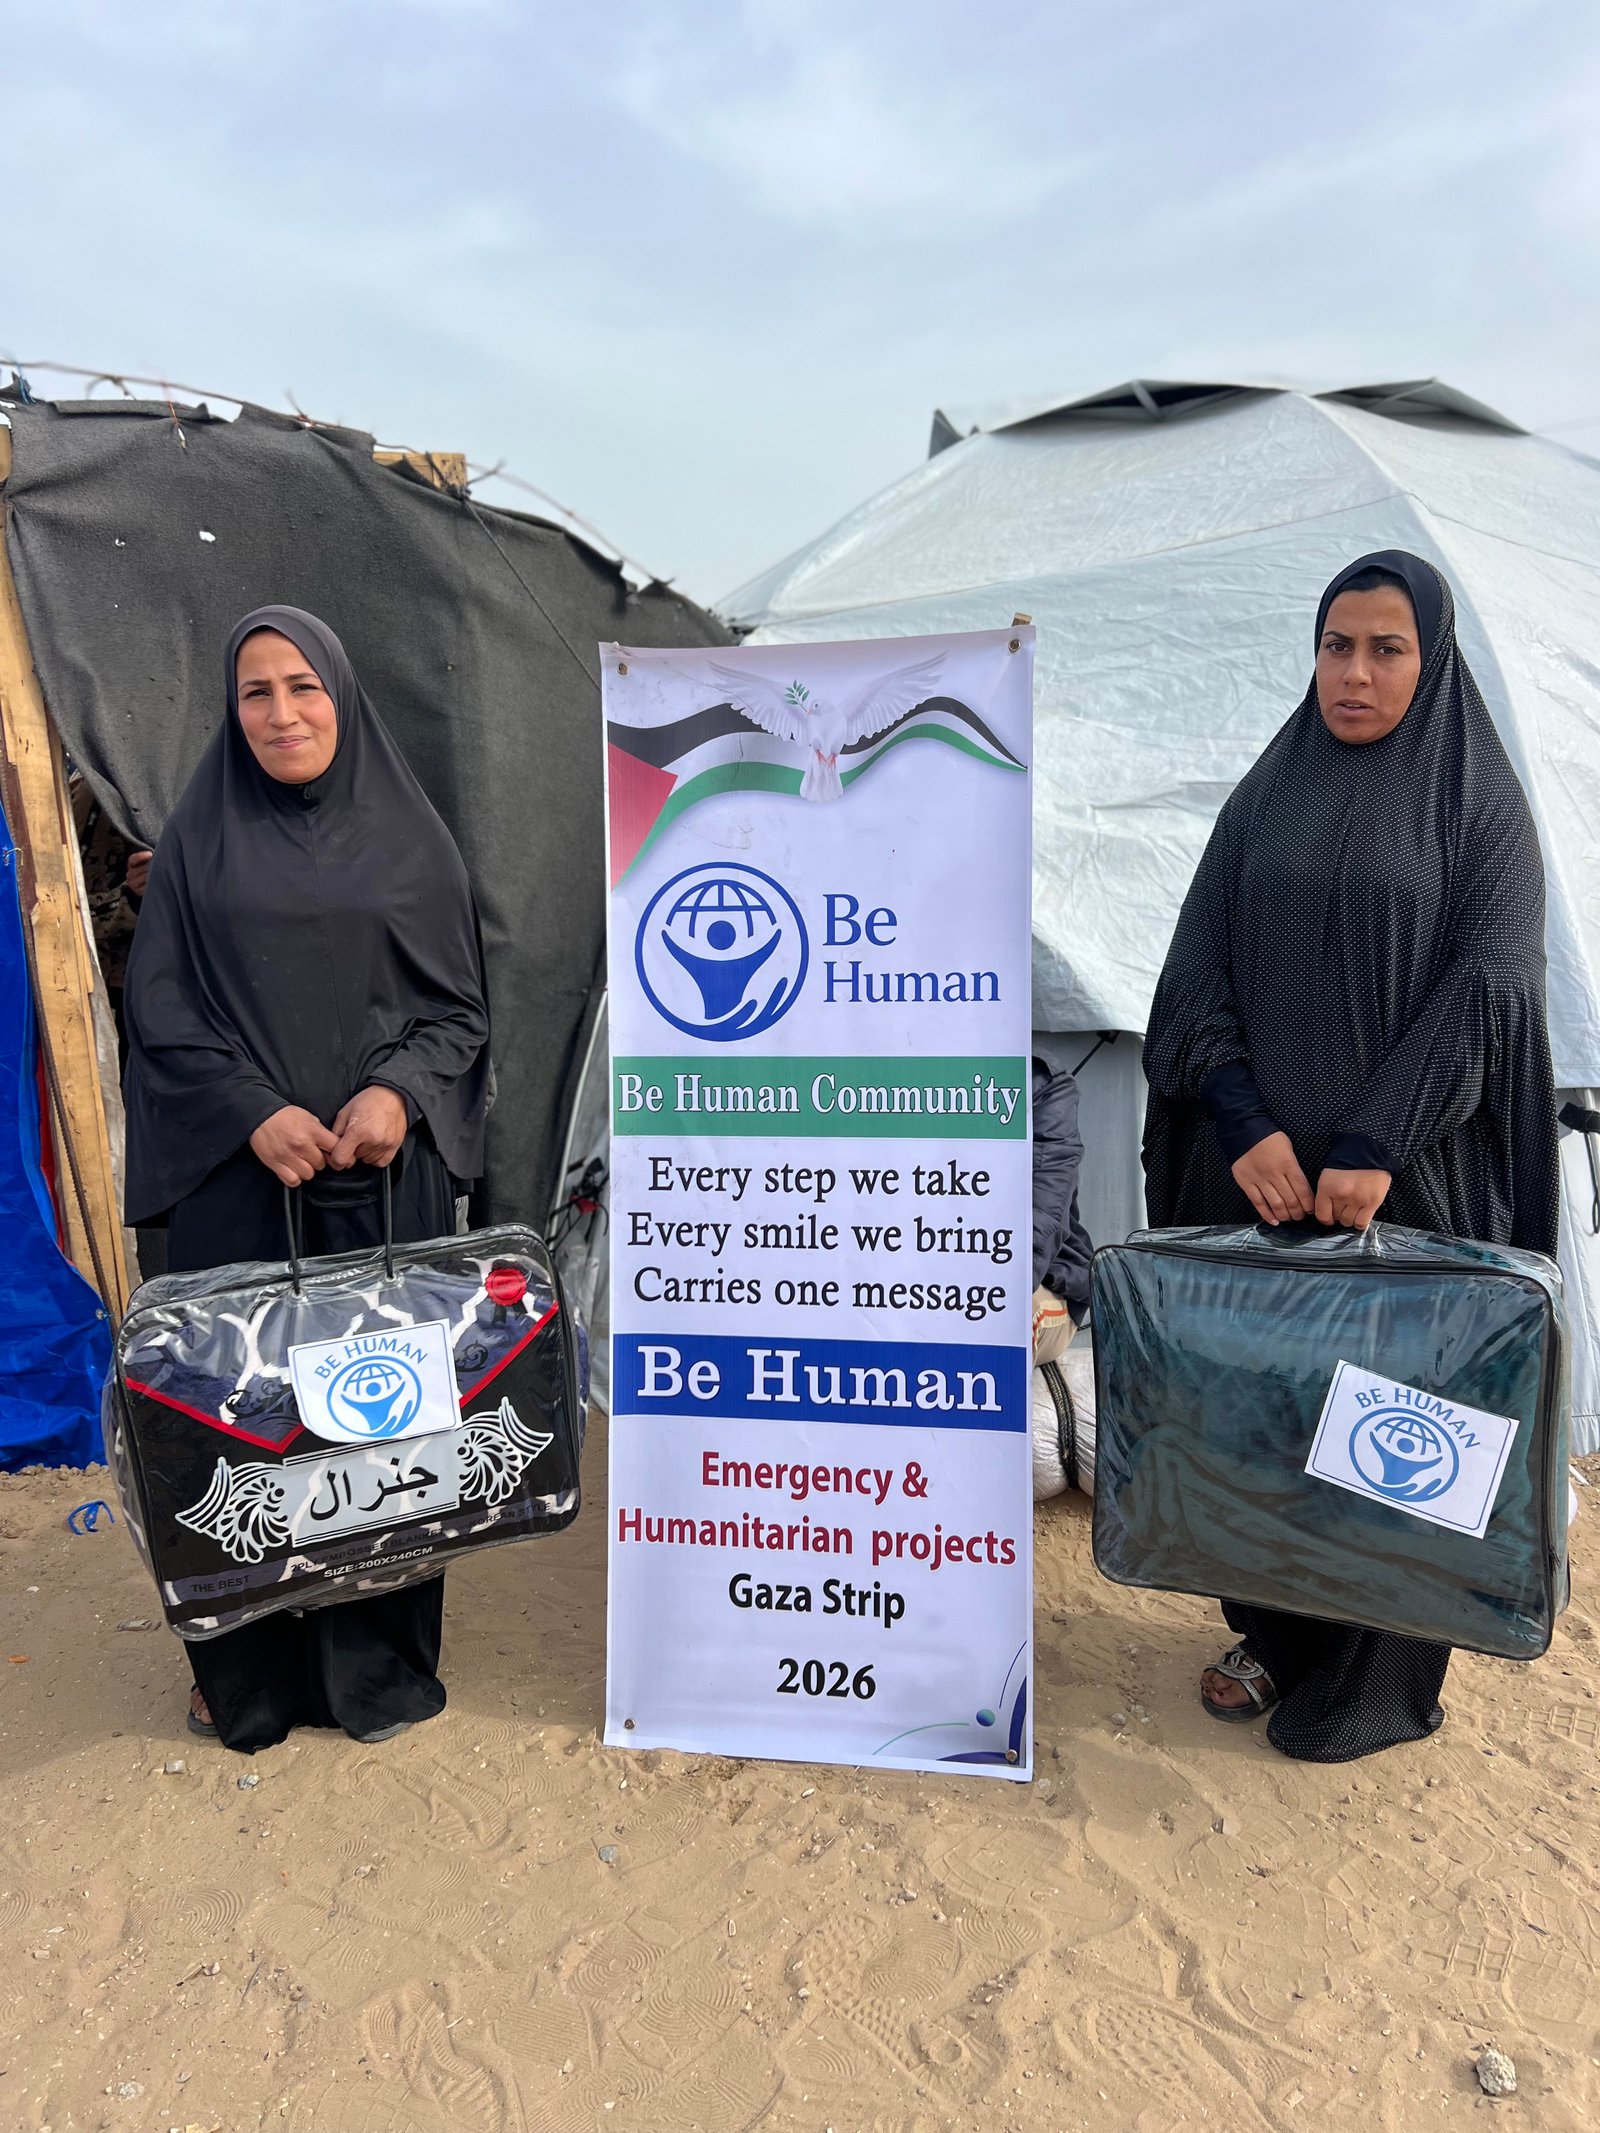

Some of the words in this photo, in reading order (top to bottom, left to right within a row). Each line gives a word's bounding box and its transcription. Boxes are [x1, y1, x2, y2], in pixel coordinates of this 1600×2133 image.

[822, 894, 898, 946] Be
[823, 960, 1002, 1003] Human
[618, 1074, 663, 1112] Be
[674, 1074, 801, 1114] Human
[811, 1073, 1022, 1125] Community
[648, 1157, 753, 1201] Every
[764, 1165, 836, 1202] step
[849, 1168, 901, 1196] we
[912, 1160, 991, 1197] take
[628, 1212, 732, 1256] Every
[744, 1214, 839, 1250] smile
[851, 1224, 902, 1252] we
[914, 1217, 1014, 1264] bring
[634, 1267, 762, 1304] Carries
[774, 1279, 840, 1307] one
[852, 1283, 1007, 1321] message
[314, 1354, 342, 1380] BE
[344, 1336, 428, 1365] HUMAN
[637, 1345, 722, 1400] Be
[746, 1348, 1002, 1412] Human
[1355, 1388, 1385, 1408] BE
[1394, 1387, 1480, 1448] HUMAN
[310, 1457, 438, 1520] جنرال
[702, 1451, 893, 1506] Emergency
[902, 1461, 929, 1498] &
[470, 1510, 516, 1526] KOREAN
[618, 1508, 853, 1555] Humanitarian
[872, 1524, 1017, 1570] projects
[191, 1583, 216, 1594] THE
[218, 1574, 250, 1591] BEST
[324, 1545, 433, 1578] SIZE:200X240CM
[728, 1573, 812, 1612] Gaza
[822, 1578, 906, 1629] Strip
[776, 1658, 877, 1700] 2026
